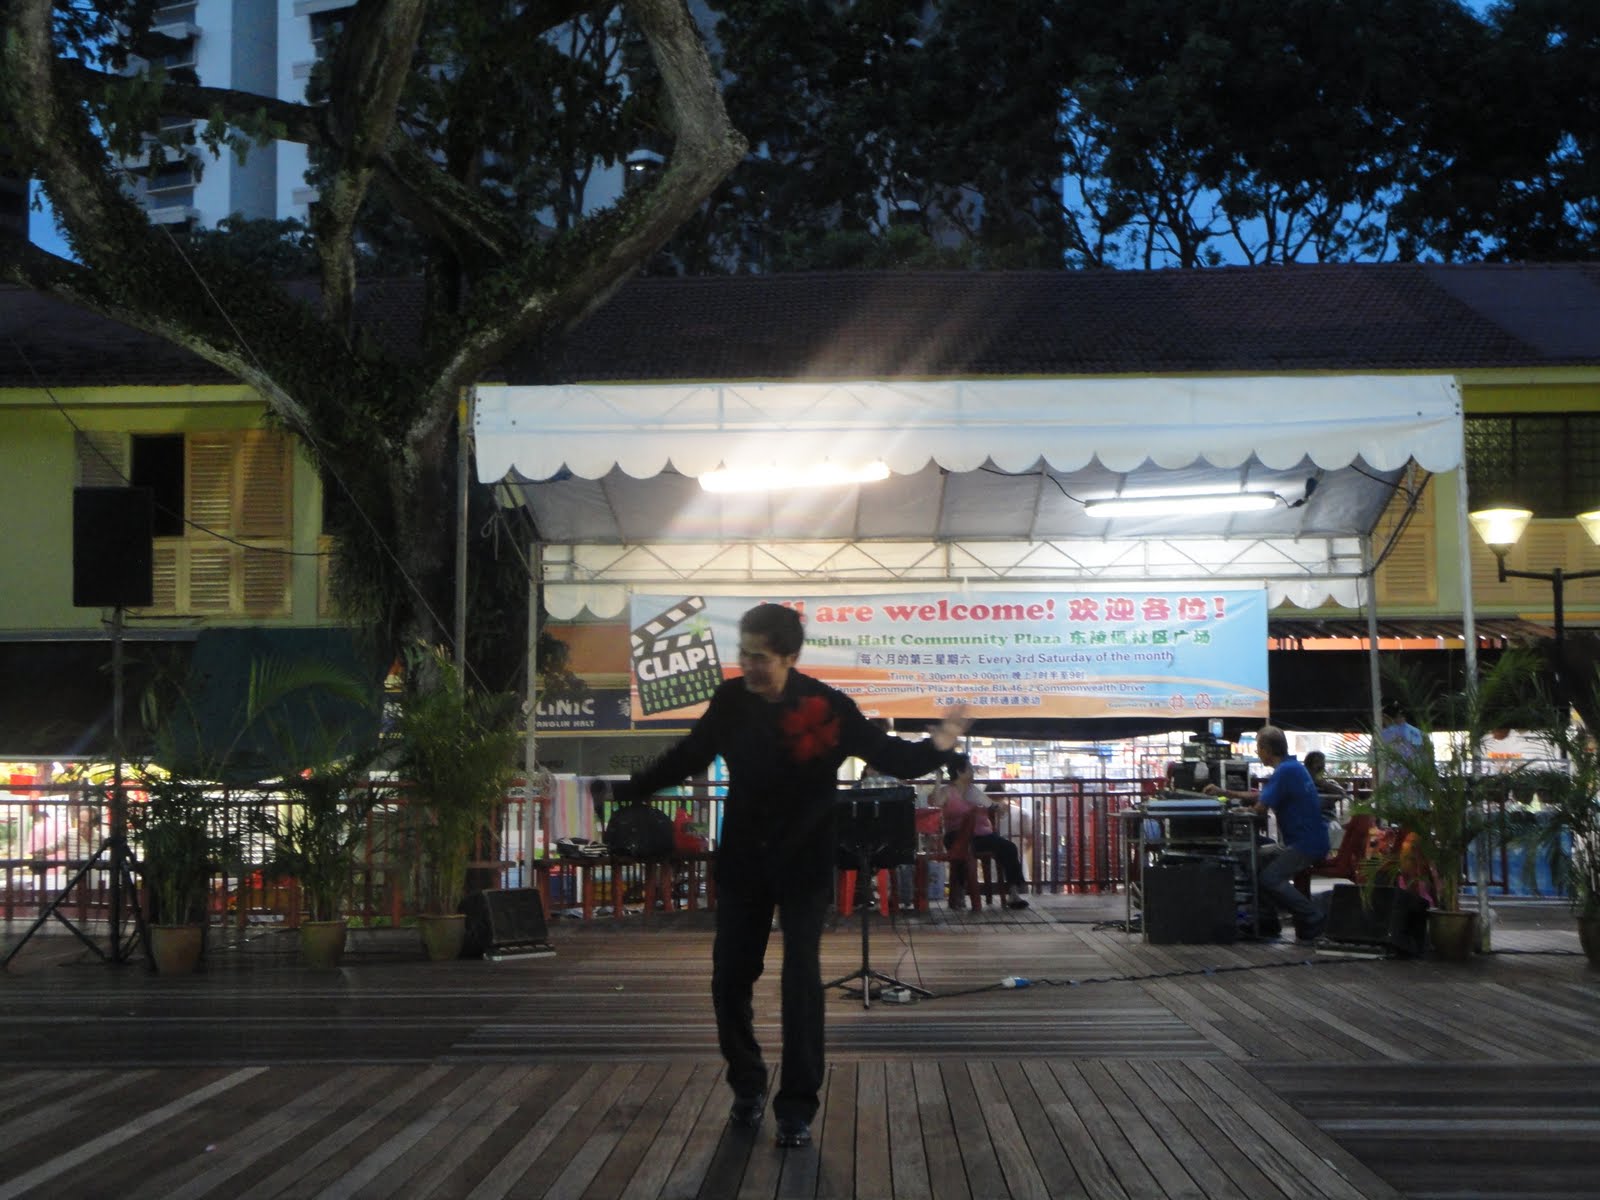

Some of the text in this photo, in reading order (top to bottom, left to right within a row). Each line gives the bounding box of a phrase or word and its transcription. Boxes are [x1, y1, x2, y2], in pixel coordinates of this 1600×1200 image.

[816, 604, 874, 622] are
[883, 599, 1055, 622] welcome!
[803, 632, 1061, 647] nglin Halt Community Plaza
[638, 644, 717, 681] CLAP!
[861, 653, 971, 665] 每个月的第三星期六
[978, 651, 1173, 665] Every 3rd Saturday of the month
[959, 672, 969, 680] to
[867, 683, 925, 694] Community
[928, 682, 954, 692] Plaza
[1037, 684, 1117, 692] Commonwealth
[1120, 683, 1146, 692] Drive
[646, 688, 715, 711] PROGRAMM
